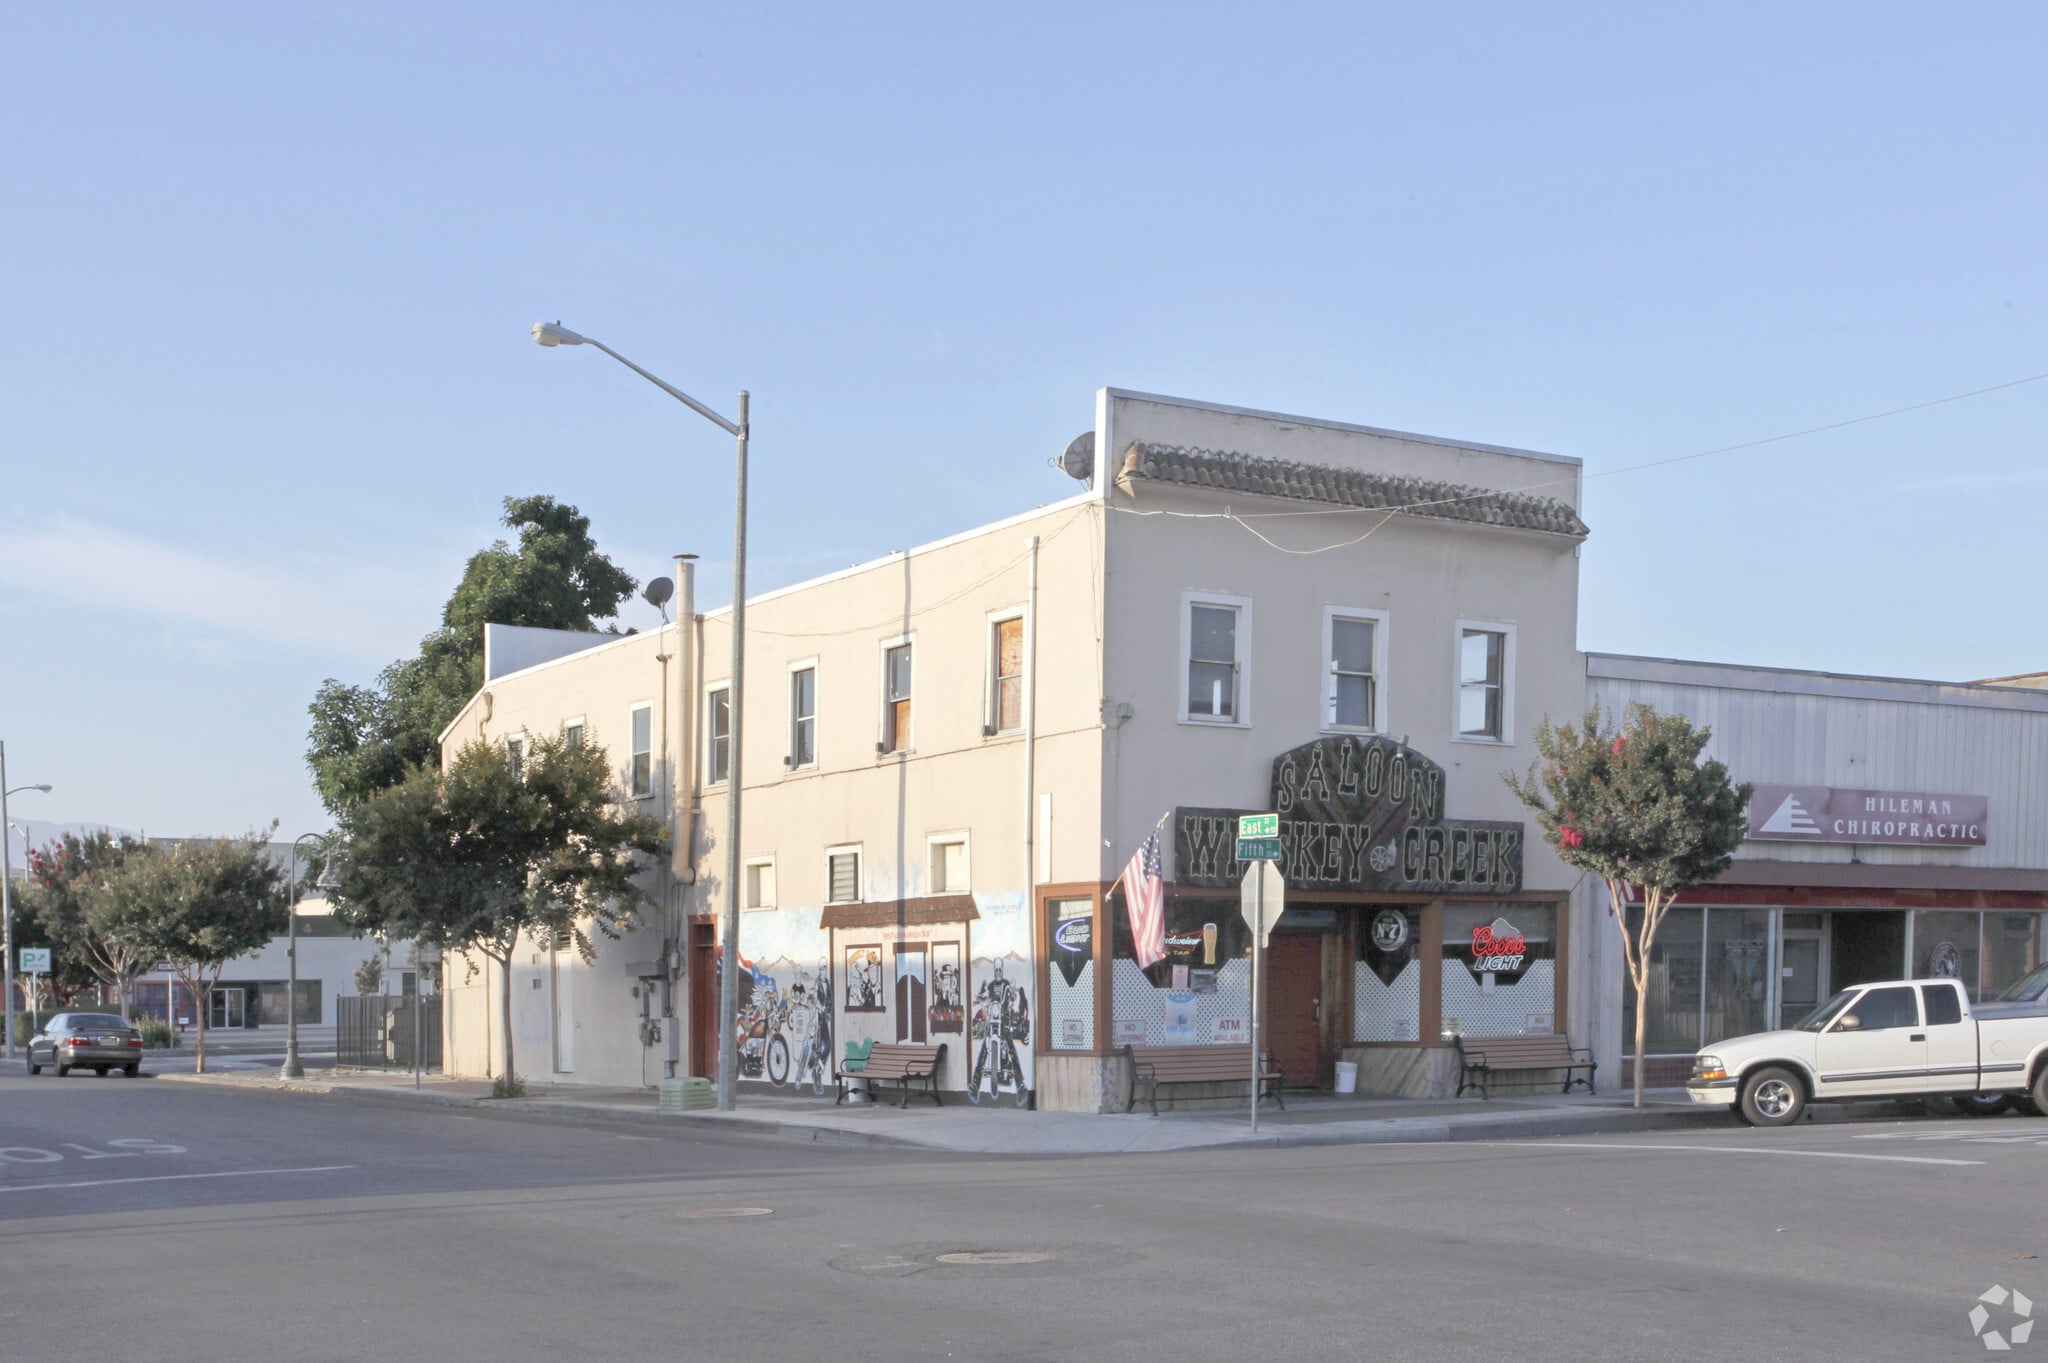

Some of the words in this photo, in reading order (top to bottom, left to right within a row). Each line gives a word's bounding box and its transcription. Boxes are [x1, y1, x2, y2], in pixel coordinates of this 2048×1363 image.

[1277, 743, 1439, 819] SALOON
[1865, 797, 1951, 815] HILEMAN
[1241, 820, 1261, 835] East
[1834, 819, 1978, 839] CHIROPRACTIC
[1184, 815, 1371, 883] WKEY
[1402, 825, 1518, 886] CREEK
[1238, 842, 1264, 857] Fifth
[1061, 934, 1090, 944] LIGHT
[1164, 935, 1202, 946] dweiser
[1472, 926, 1526, 957] Coors
[24, 953, 36, 968] P
[1474, 955, 1524, 971] LIGHT
[1123, 1023, 1136, 1032] NO
[1219, 1020, 1240, 1031] ATM
[0, 1138, 188, 1166] STO
